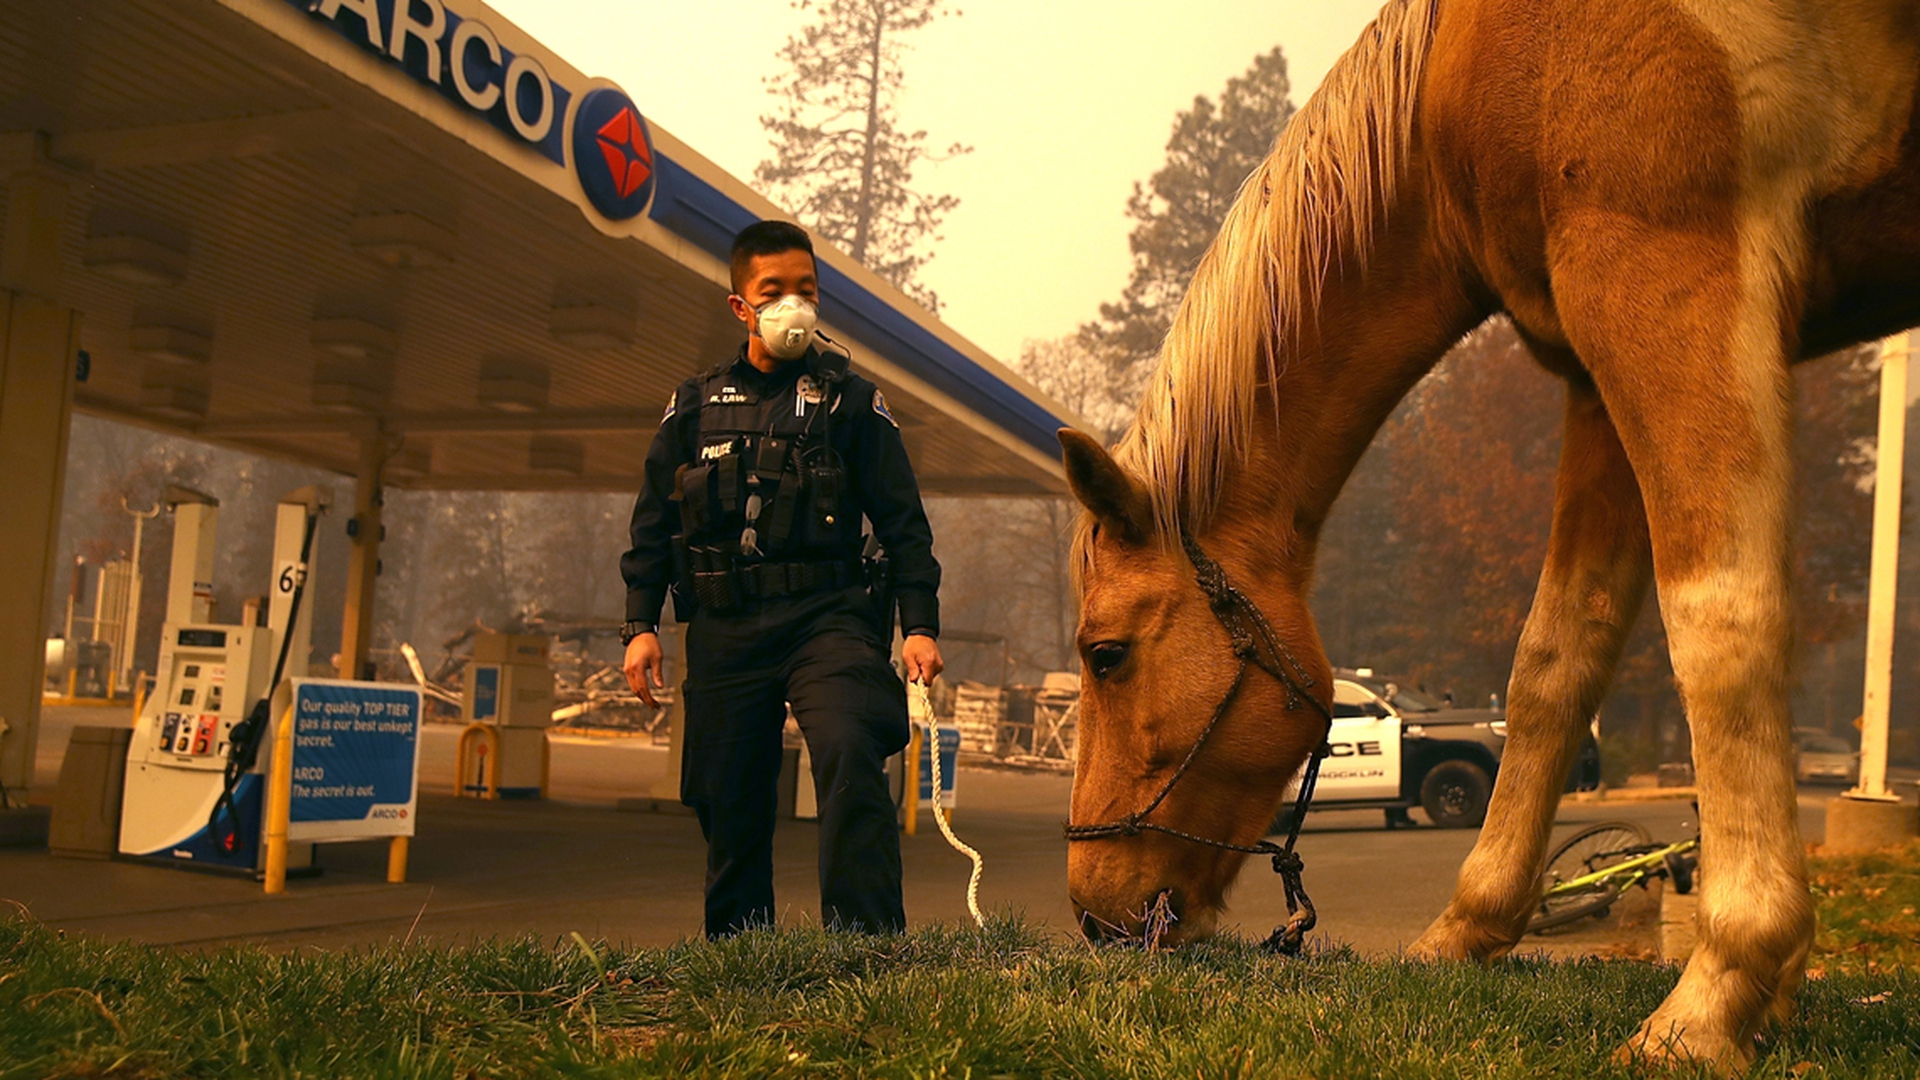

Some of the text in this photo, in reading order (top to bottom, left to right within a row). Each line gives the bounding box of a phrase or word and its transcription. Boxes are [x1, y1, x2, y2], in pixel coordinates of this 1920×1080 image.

[320, 0, 554, 142] ARCO
[701, 441, 732, 459] POLICE
[302, 698, 410, 717] Our quality TOP TIER
[299, 717, 413, 735] gas is our best unkept
[296, 735, 334, 747] secret.
[1329, 741, 1382, 757] CE
[294, 767, 324, 780] ARCO
[293, 784, 376, 798] The secret is out.
[372, 808, 398, 819] ARCO
